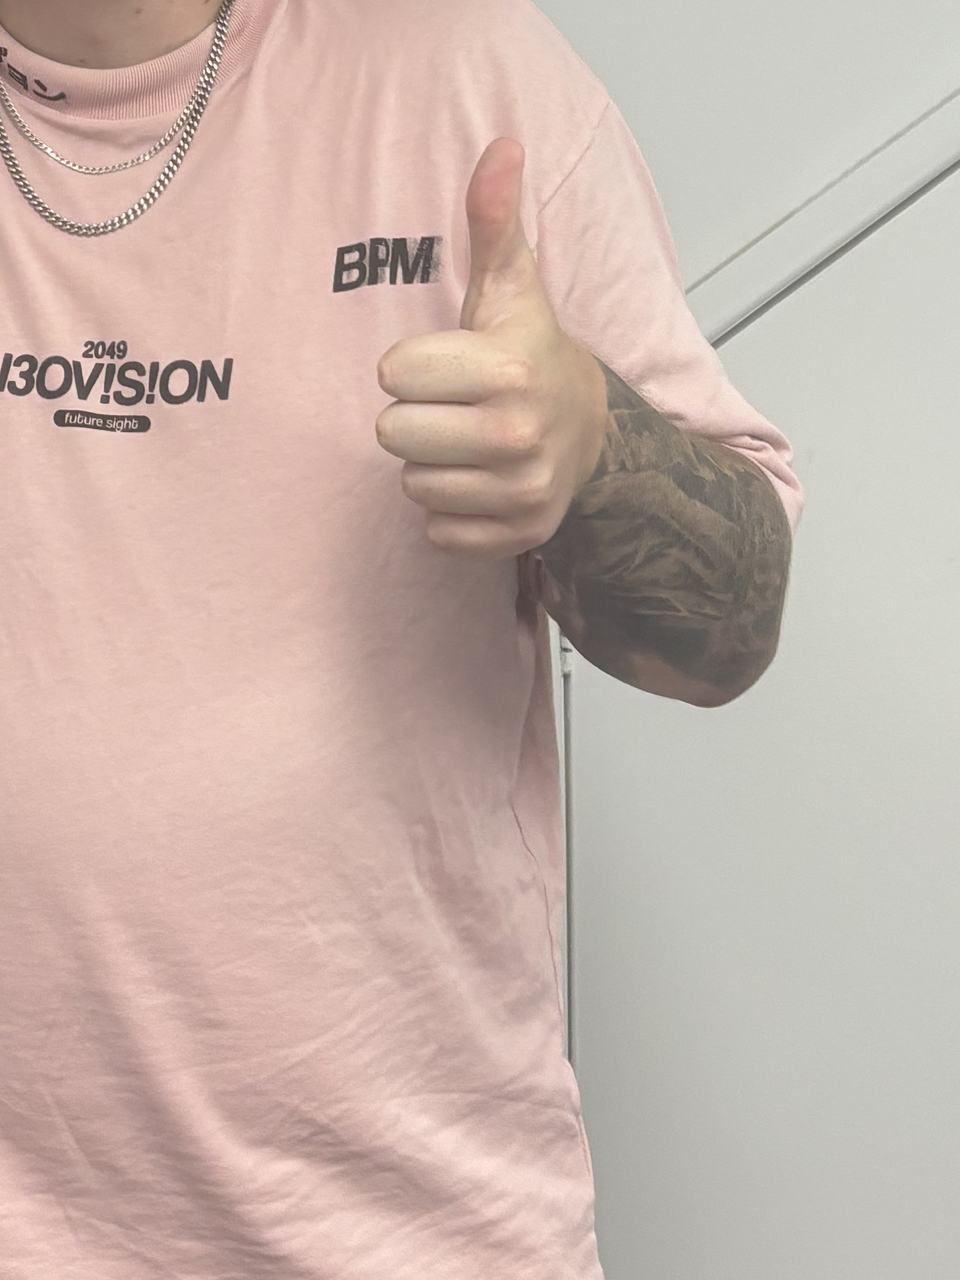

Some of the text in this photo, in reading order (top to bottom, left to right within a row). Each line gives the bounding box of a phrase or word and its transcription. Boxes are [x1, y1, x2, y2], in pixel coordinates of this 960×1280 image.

[332, 235, 442, 293] BPM
[82, 340, 128, 360] 2049
[64, 412, 139, 433] future sight
